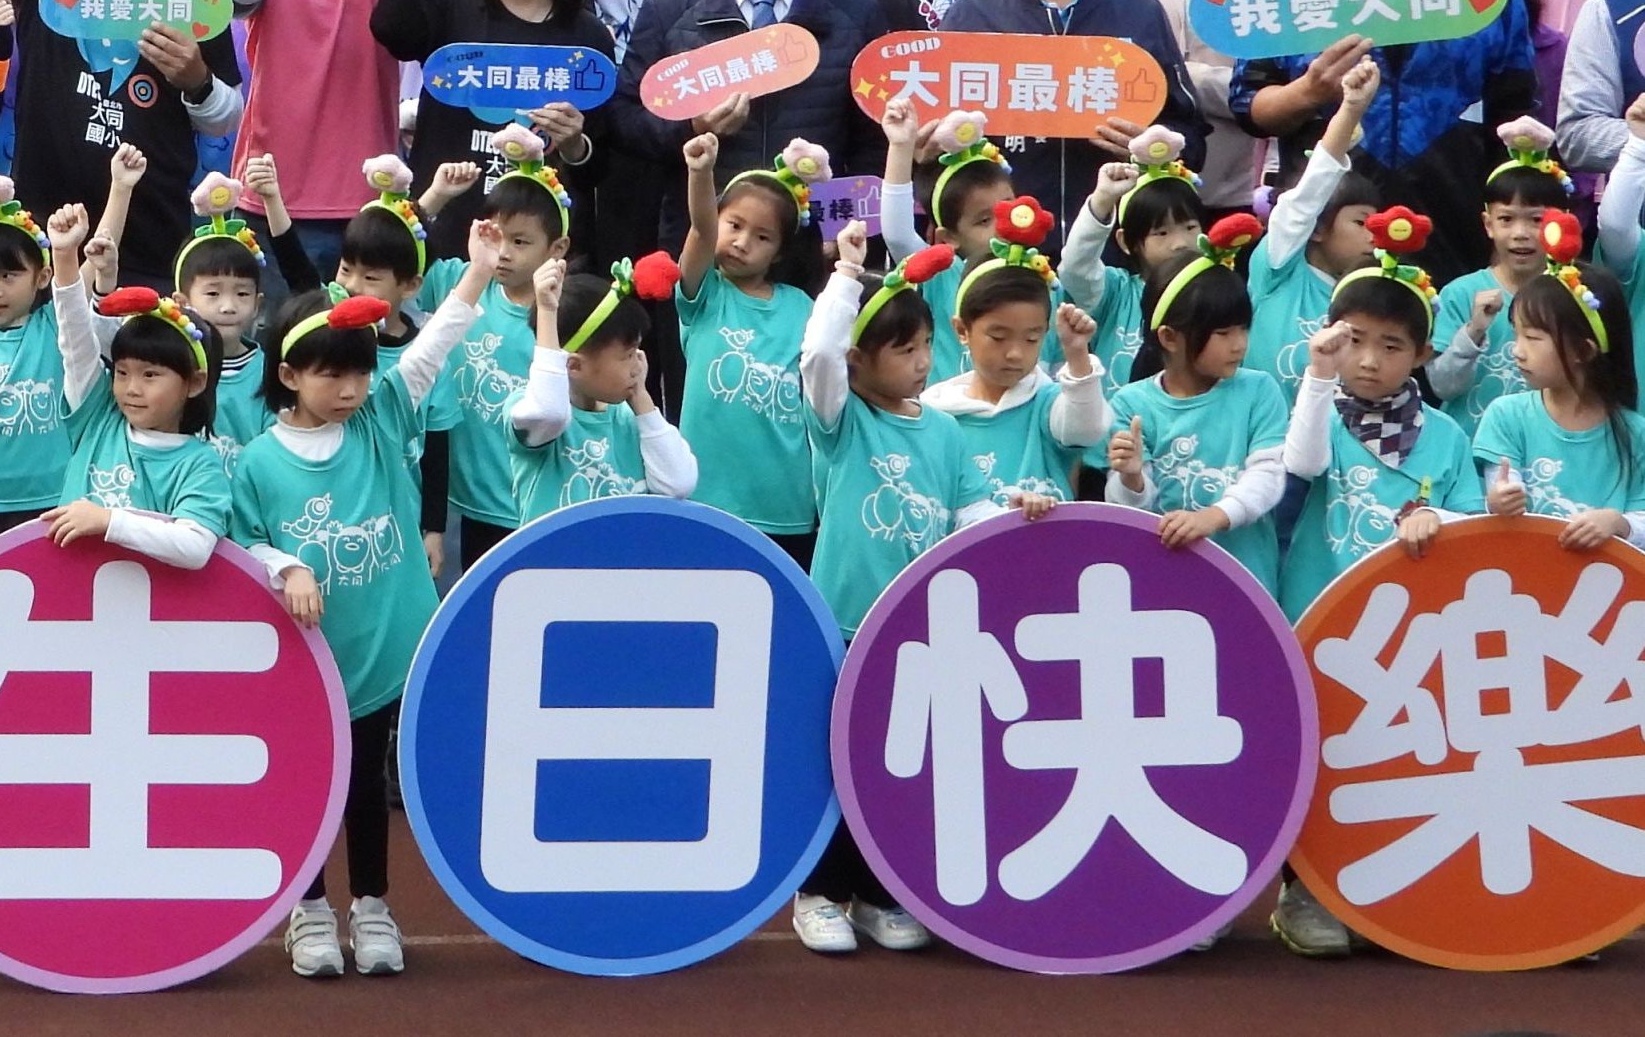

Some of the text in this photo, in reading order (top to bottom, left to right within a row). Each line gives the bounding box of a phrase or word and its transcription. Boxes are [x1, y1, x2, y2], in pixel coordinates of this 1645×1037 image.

[881, 36, 941, 59] GOOD
[457, 65, 571, 92] 大同最棒
[672, 49, 778, 100] 大同最棒
[888, 61, 1121, 114] 大同最棒
[85, 122, 121, 148] 國小
[89, 102, 124, 131] 大同
[480, 568, 773, 892] 日
[884, 562, 1248, 905] 快
[1314, 562, 1645, 905] 樂
